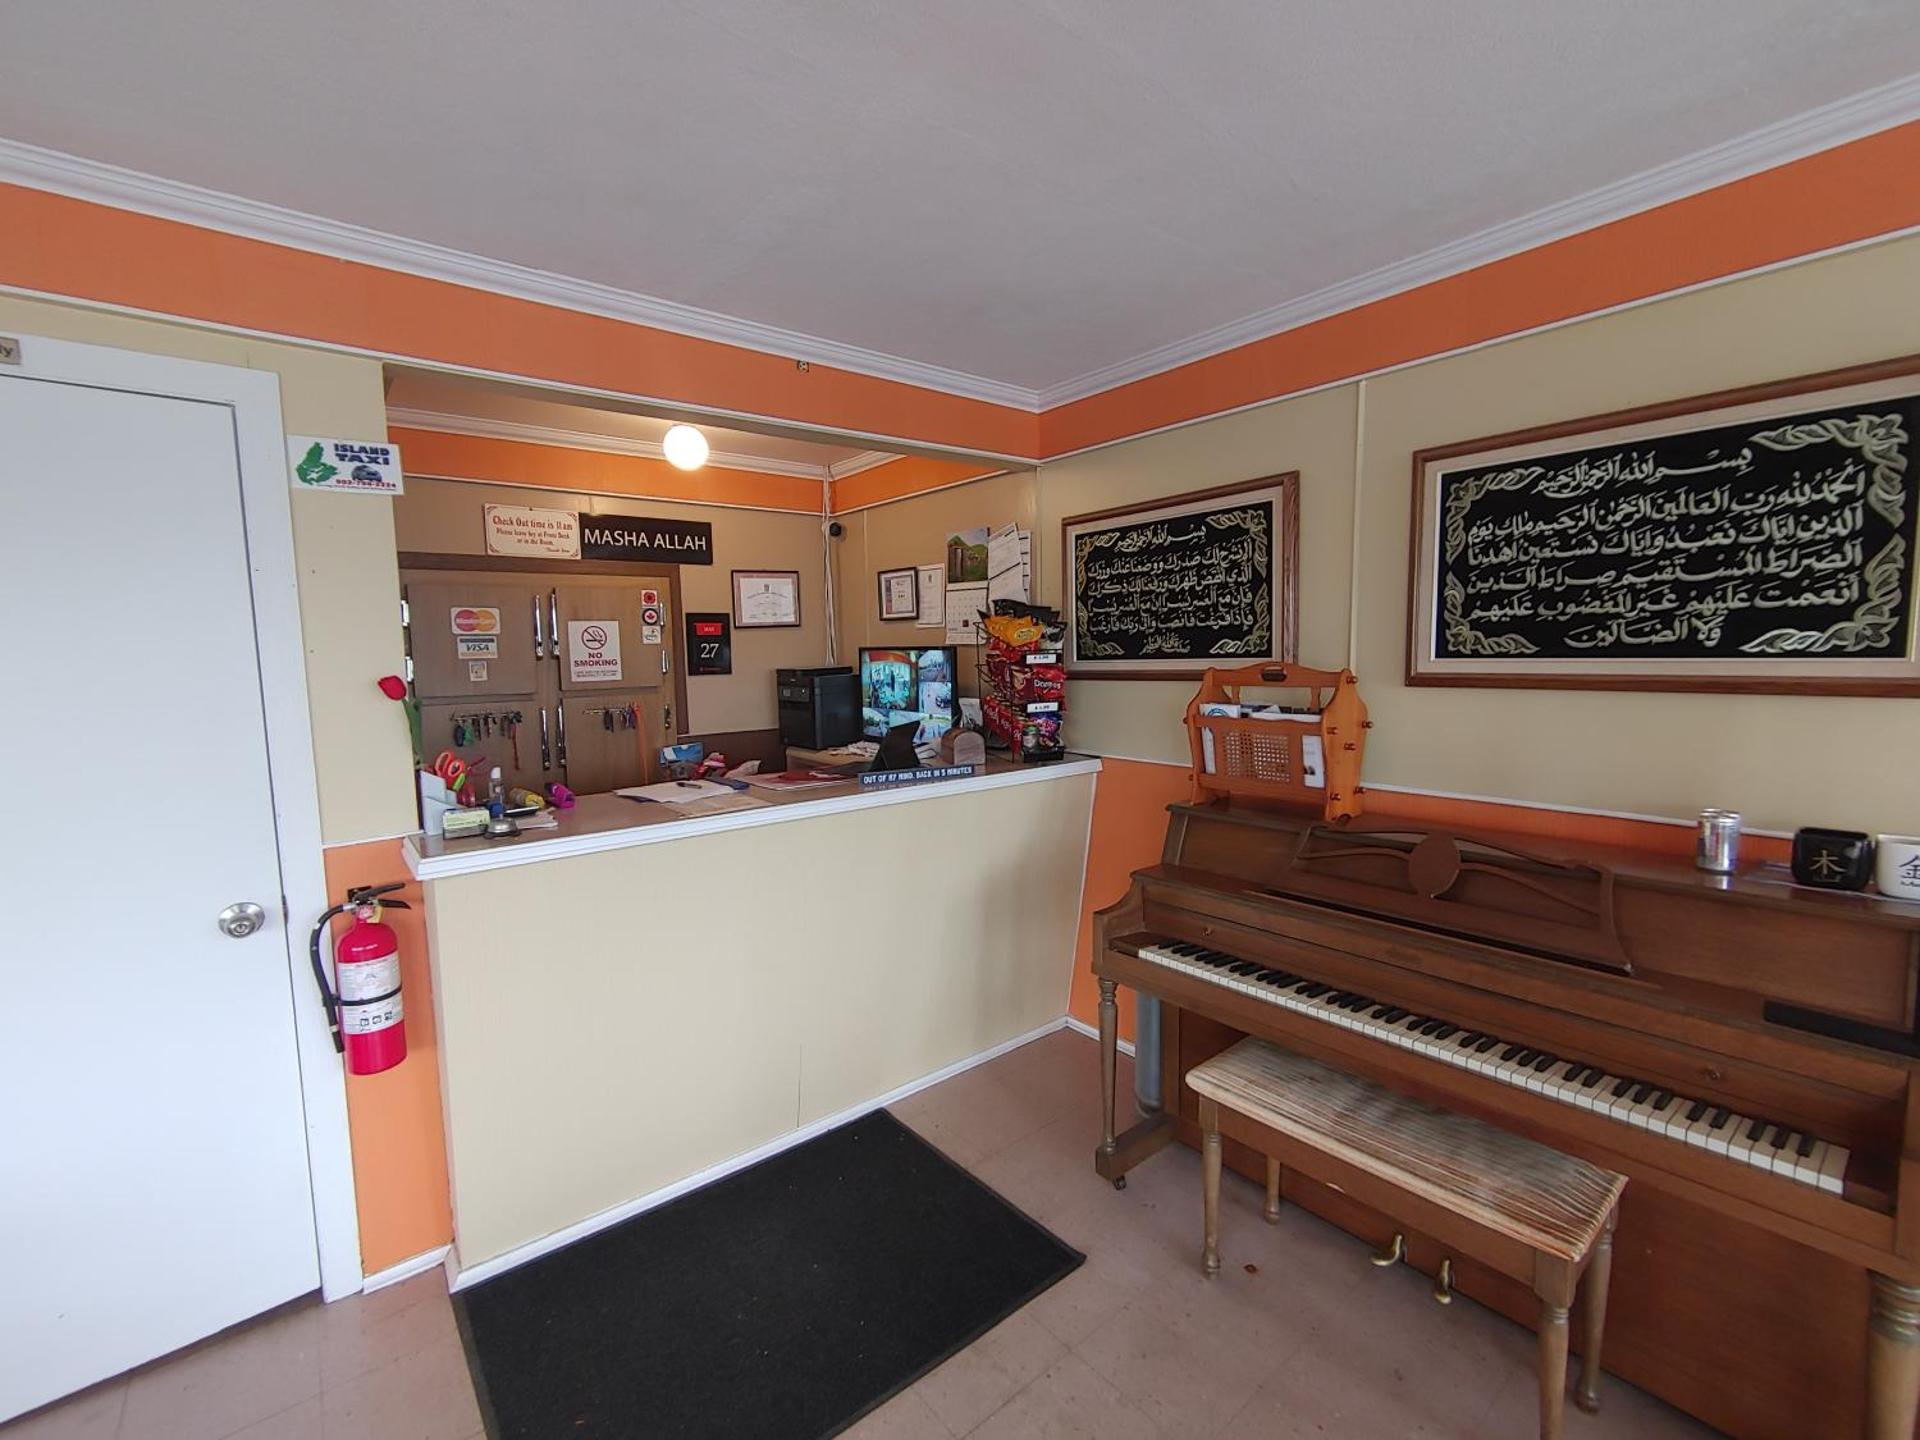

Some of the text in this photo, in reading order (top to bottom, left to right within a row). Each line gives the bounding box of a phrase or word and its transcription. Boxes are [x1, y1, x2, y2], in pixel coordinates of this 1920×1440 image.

[334, 443, 390, 456] ISLAND
[335, 452, 390, 466] TAXI
[492, 515, 514, 526] Check
[515, 518, 529, 528] Out
[530, 520, 545, 529] time
[547, 519, 554, 529] is
[584, 528, 707, 551] MASHA ALLAH
[466, 643, 490, 652] VISA
[700, 642, 719, 658] 27
[574, 658, 618, 668] SMOKING
[863, 775, 876, 784] OUT
[877, 774, 886, 783] OF
[916, 769, 932, 779] BACK
[933, 768, 940, 777] IN
[941, 767, 946, 777] 5
[947, 765, 973, 776] MINUTES
[1809, 849, 1847, 876] 木
